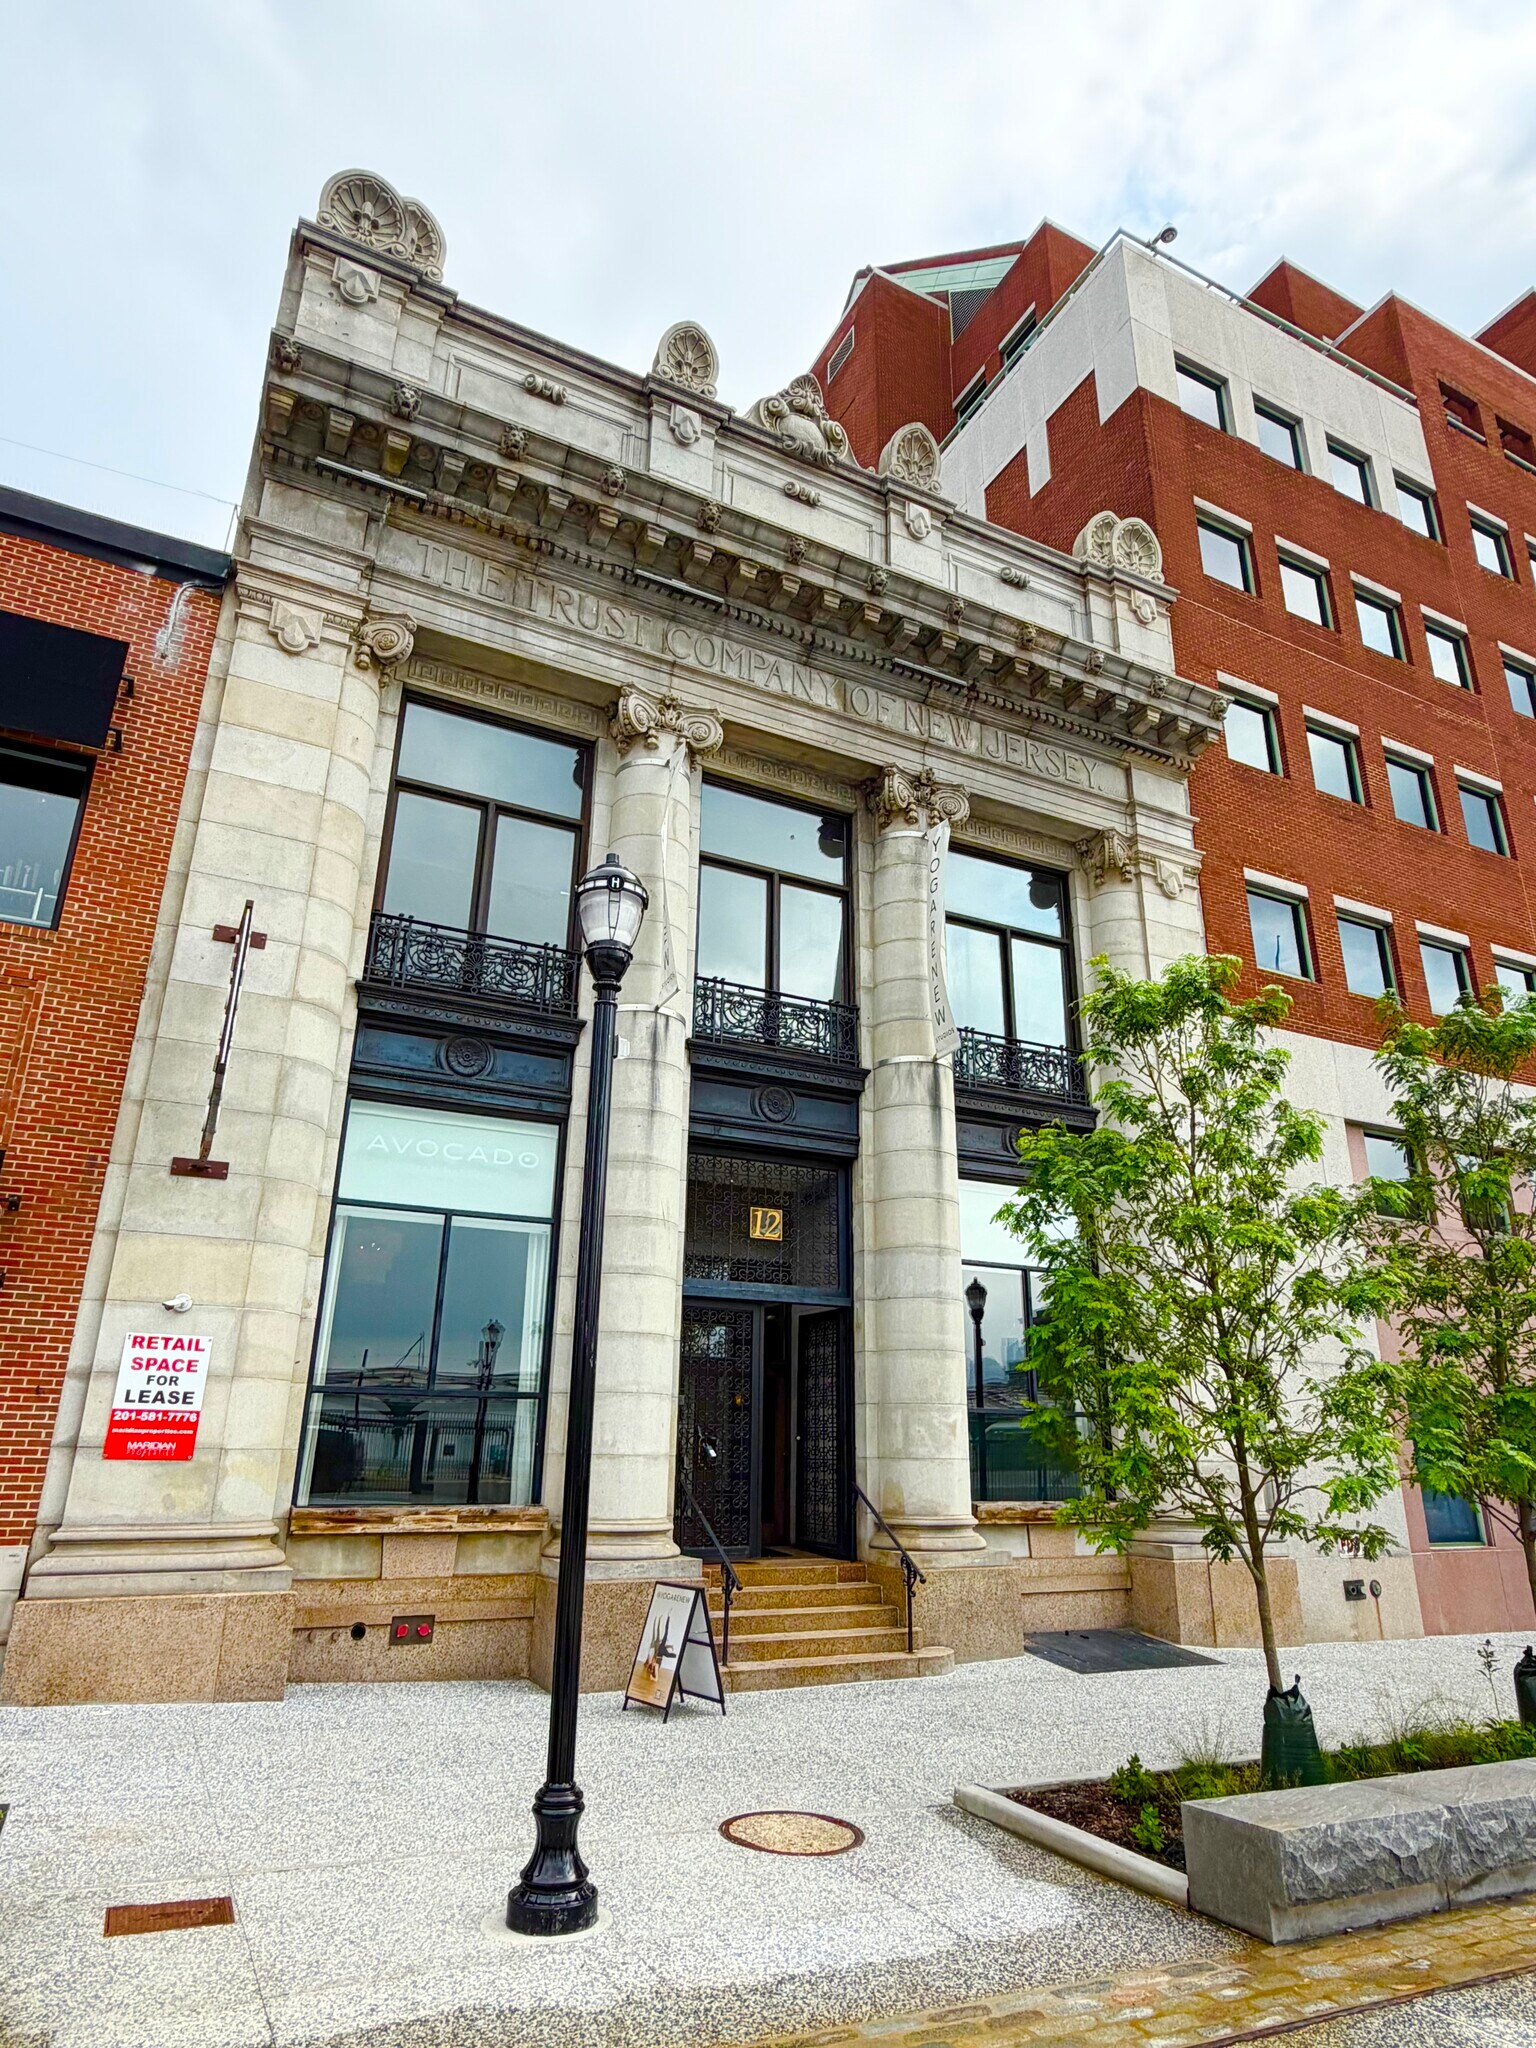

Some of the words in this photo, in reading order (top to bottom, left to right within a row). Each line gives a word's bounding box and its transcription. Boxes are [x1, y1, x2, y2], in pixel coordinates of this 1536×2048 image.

[417, 539, 508, 598] THE
[522, 575, 652, 647] TRUST
[666, 622, 839, 708] COMPANY
[850, 684, 897, 724] OF
[905, 703, 973, 751] NEW
[929, 836, 946, 1027] YOGARENEW
[366, 1134, 540, 1169] AVOCADO
[752, 1210, 781, 1238] 12
[131, 1335, 205, 1352] RETAIL
[130, 1356, 199, 1373] SPACE
[146, 1375, 179, 1386] FOR
[124, 1389, 195, 1405] LEASE
[112, 1411, 198, 1423] 201-581-7776
[126, 1441, 177, 1450] MARIDIAN
